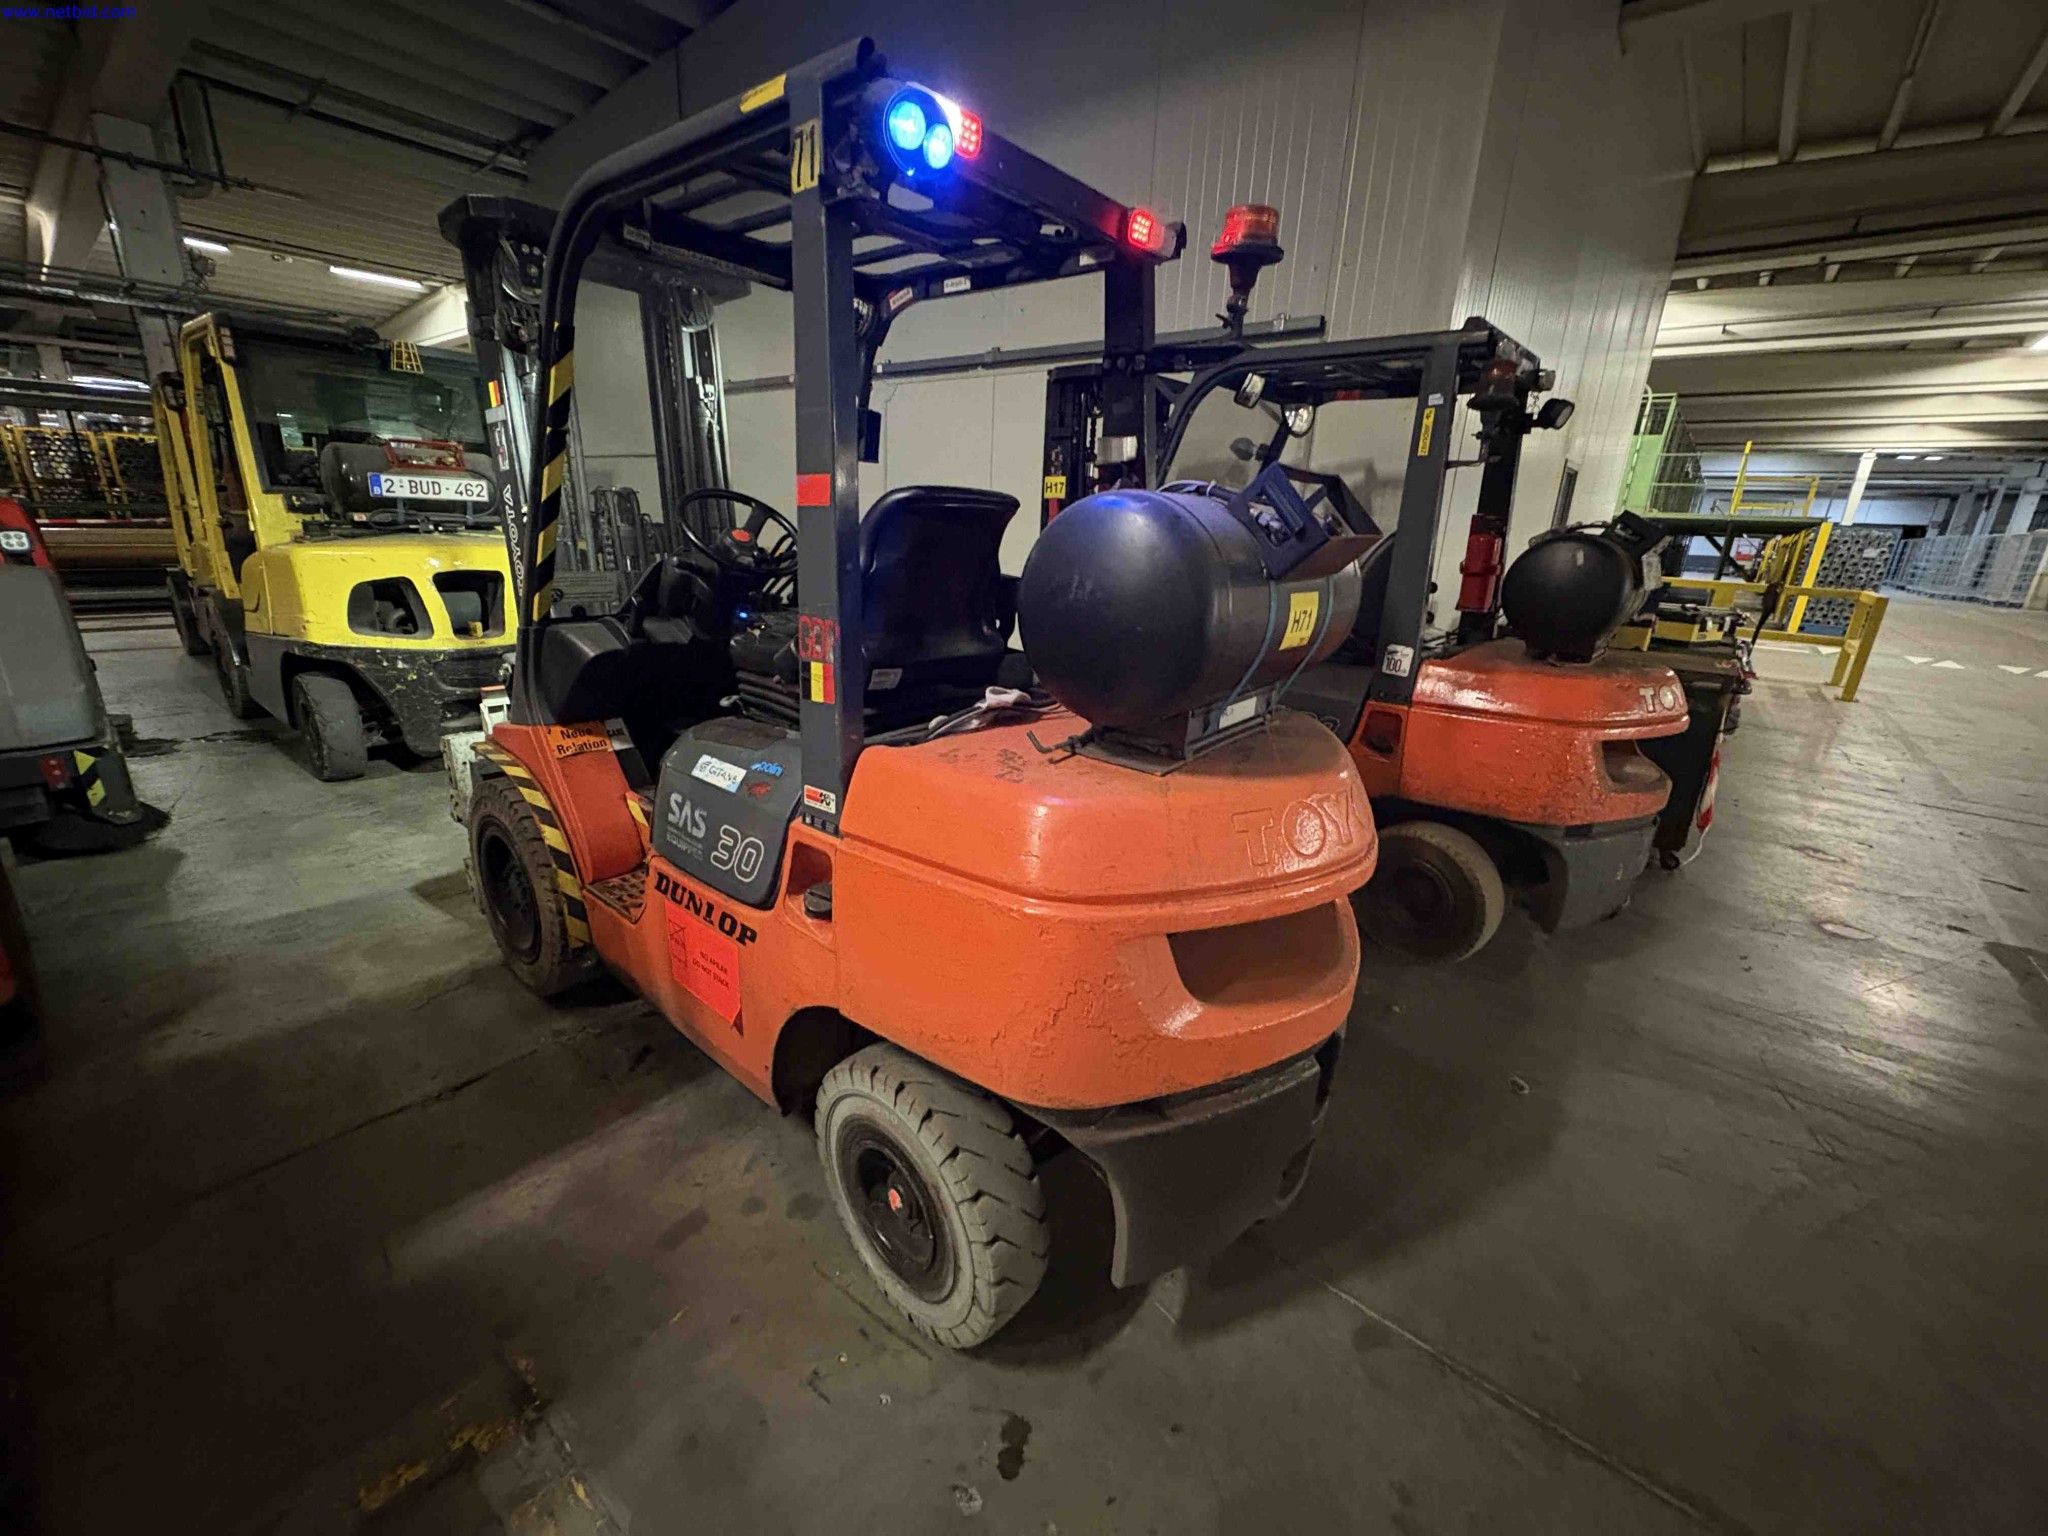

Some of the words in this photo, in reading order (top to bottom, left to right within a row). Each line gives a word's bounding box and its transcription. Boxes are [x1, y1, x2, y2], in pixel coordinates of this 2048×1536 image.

[1045, 481, 1065, 494] H17
[1290, 609, 1313, 634] H71
[556, 738, 607, 755] Relation
[668, 792, 707, 839] SAS
[710, 824, 765, 883] 30
[654, 871, 758, 946] DUNLOP
